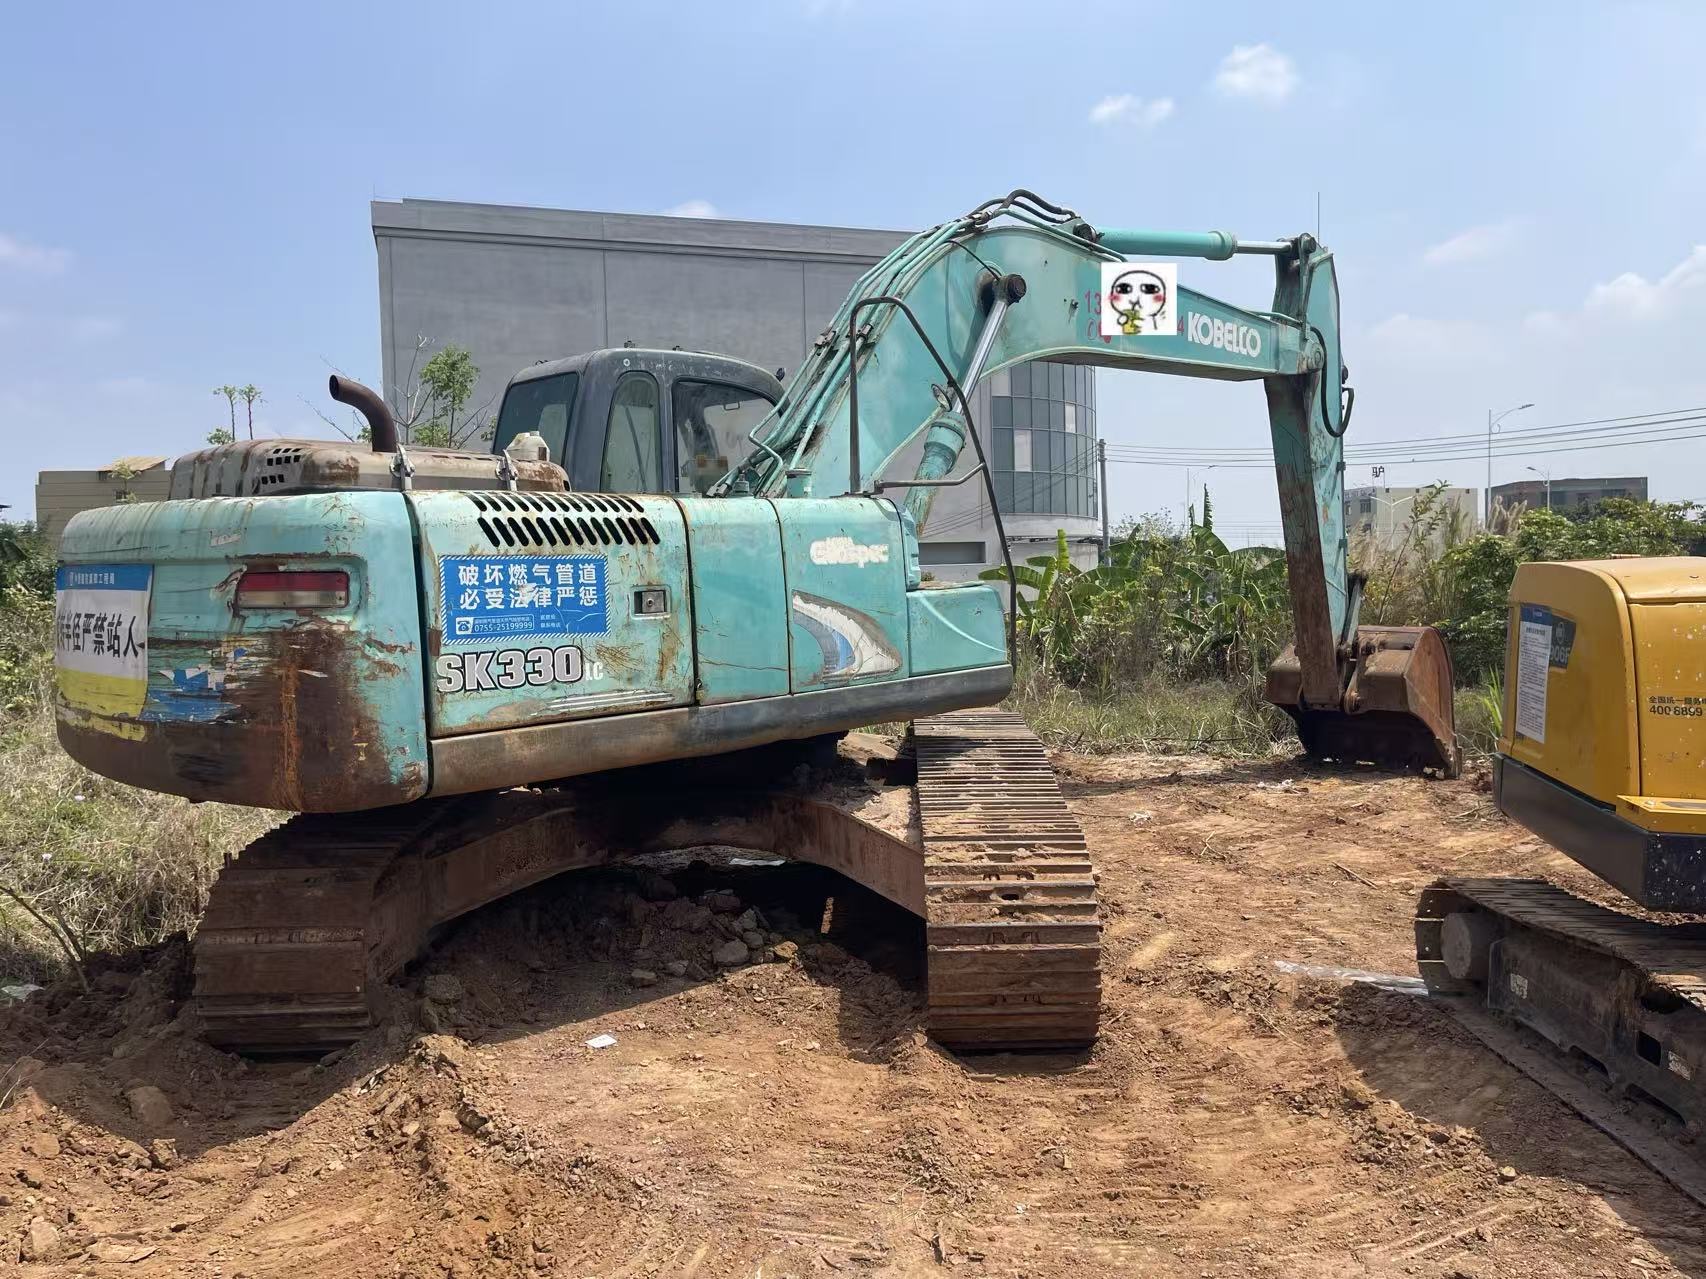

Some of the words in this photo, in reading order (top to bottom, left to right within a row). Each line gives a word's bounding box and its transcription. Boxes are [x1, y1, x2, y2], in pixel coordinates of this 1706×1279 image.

[1188, 311, 1261, 358] KOBELCO
[458, 564, 597, 586] 破坏燃气管道
[459, 586, 598, 610] 必受法律严惩
[436, 645, 584, 693] SK330
